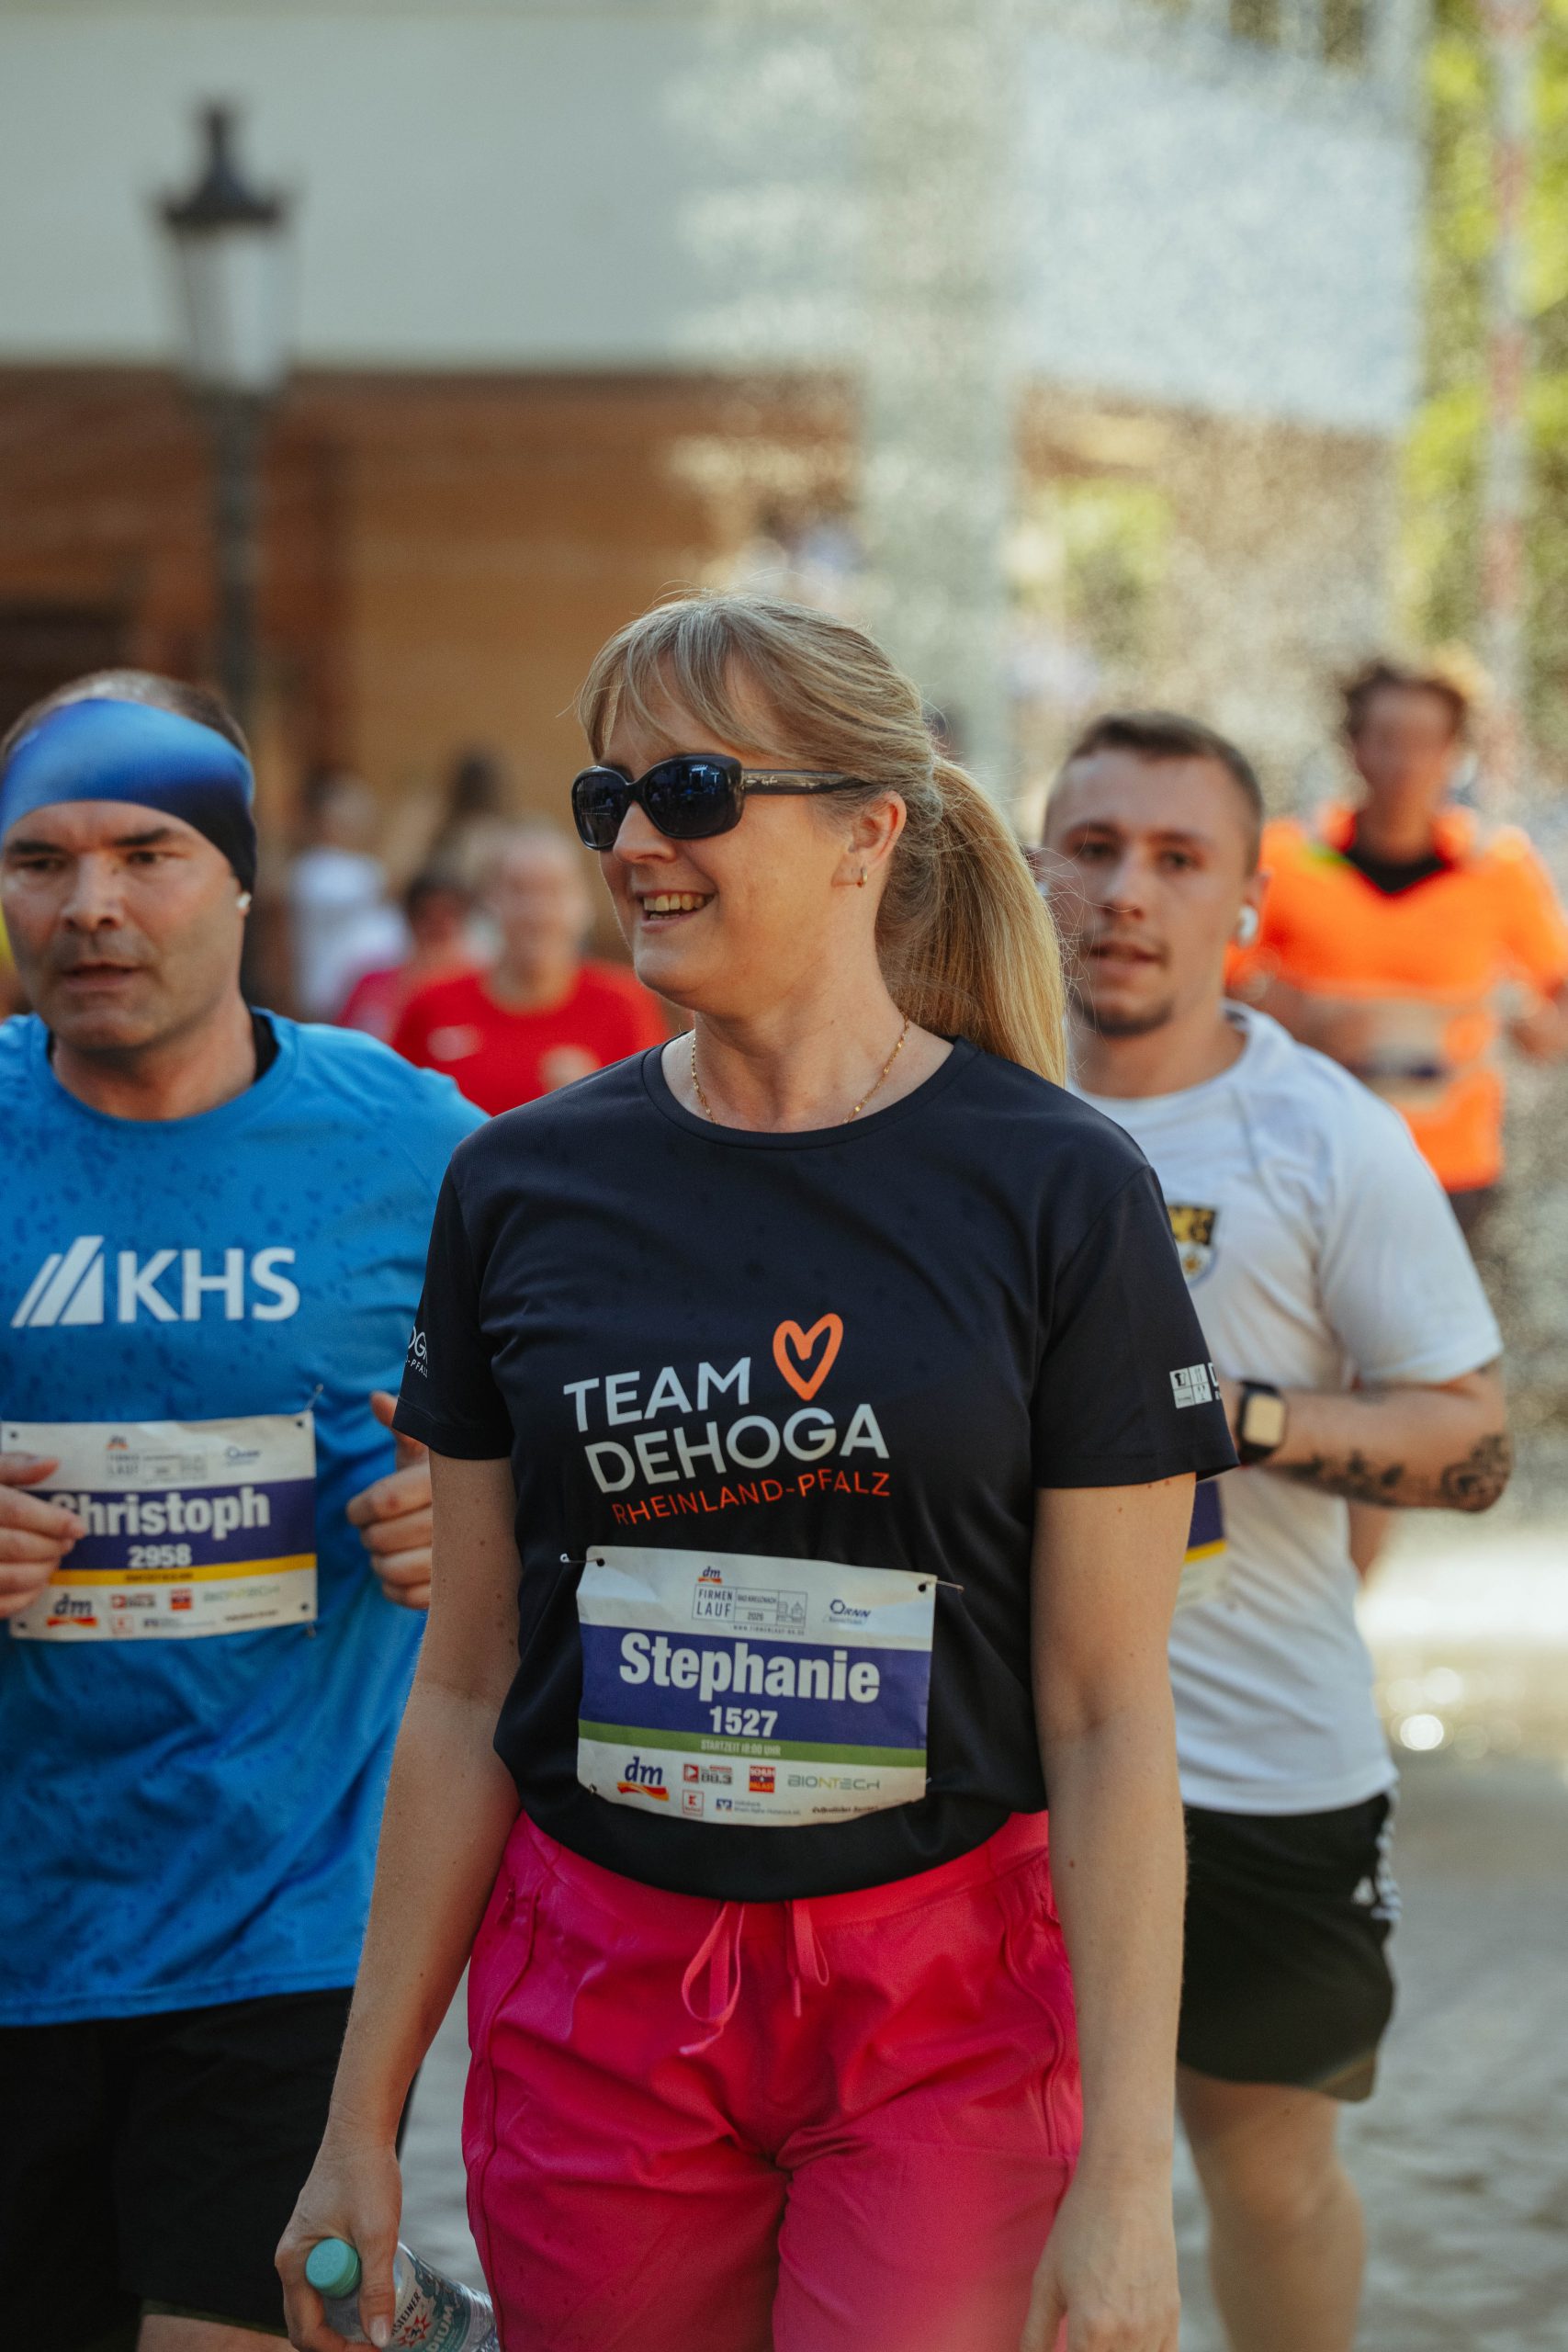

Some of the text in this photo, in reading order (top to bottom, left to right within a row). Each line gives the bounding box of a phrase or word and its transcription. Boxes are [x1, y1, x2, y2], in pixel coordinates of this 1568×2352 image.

[118, 1247, 300, 1323] KHS
[563, 1356, 750, 1432] TEAM
[584, 1403, 890, 1494] DEHOGA
[613, 1468, 890, 1525] RHEINLAND-PFALZ
[128, 1544, 192, 1569] 2958
[703, 1566, 721, 1577] dm
[54, 1594, 93, 1615] dm
[696, 1601, 732, 1618] LAUF
[698, 1589, 733, 1601] FIRMEN
[619, 1632, 880, 1703] Stephanie
[709, 1706, 778, 1737] 1527
[625, 1756, 664, 1786] dm
[788, 1774, 880, 1791] BIONTECH
